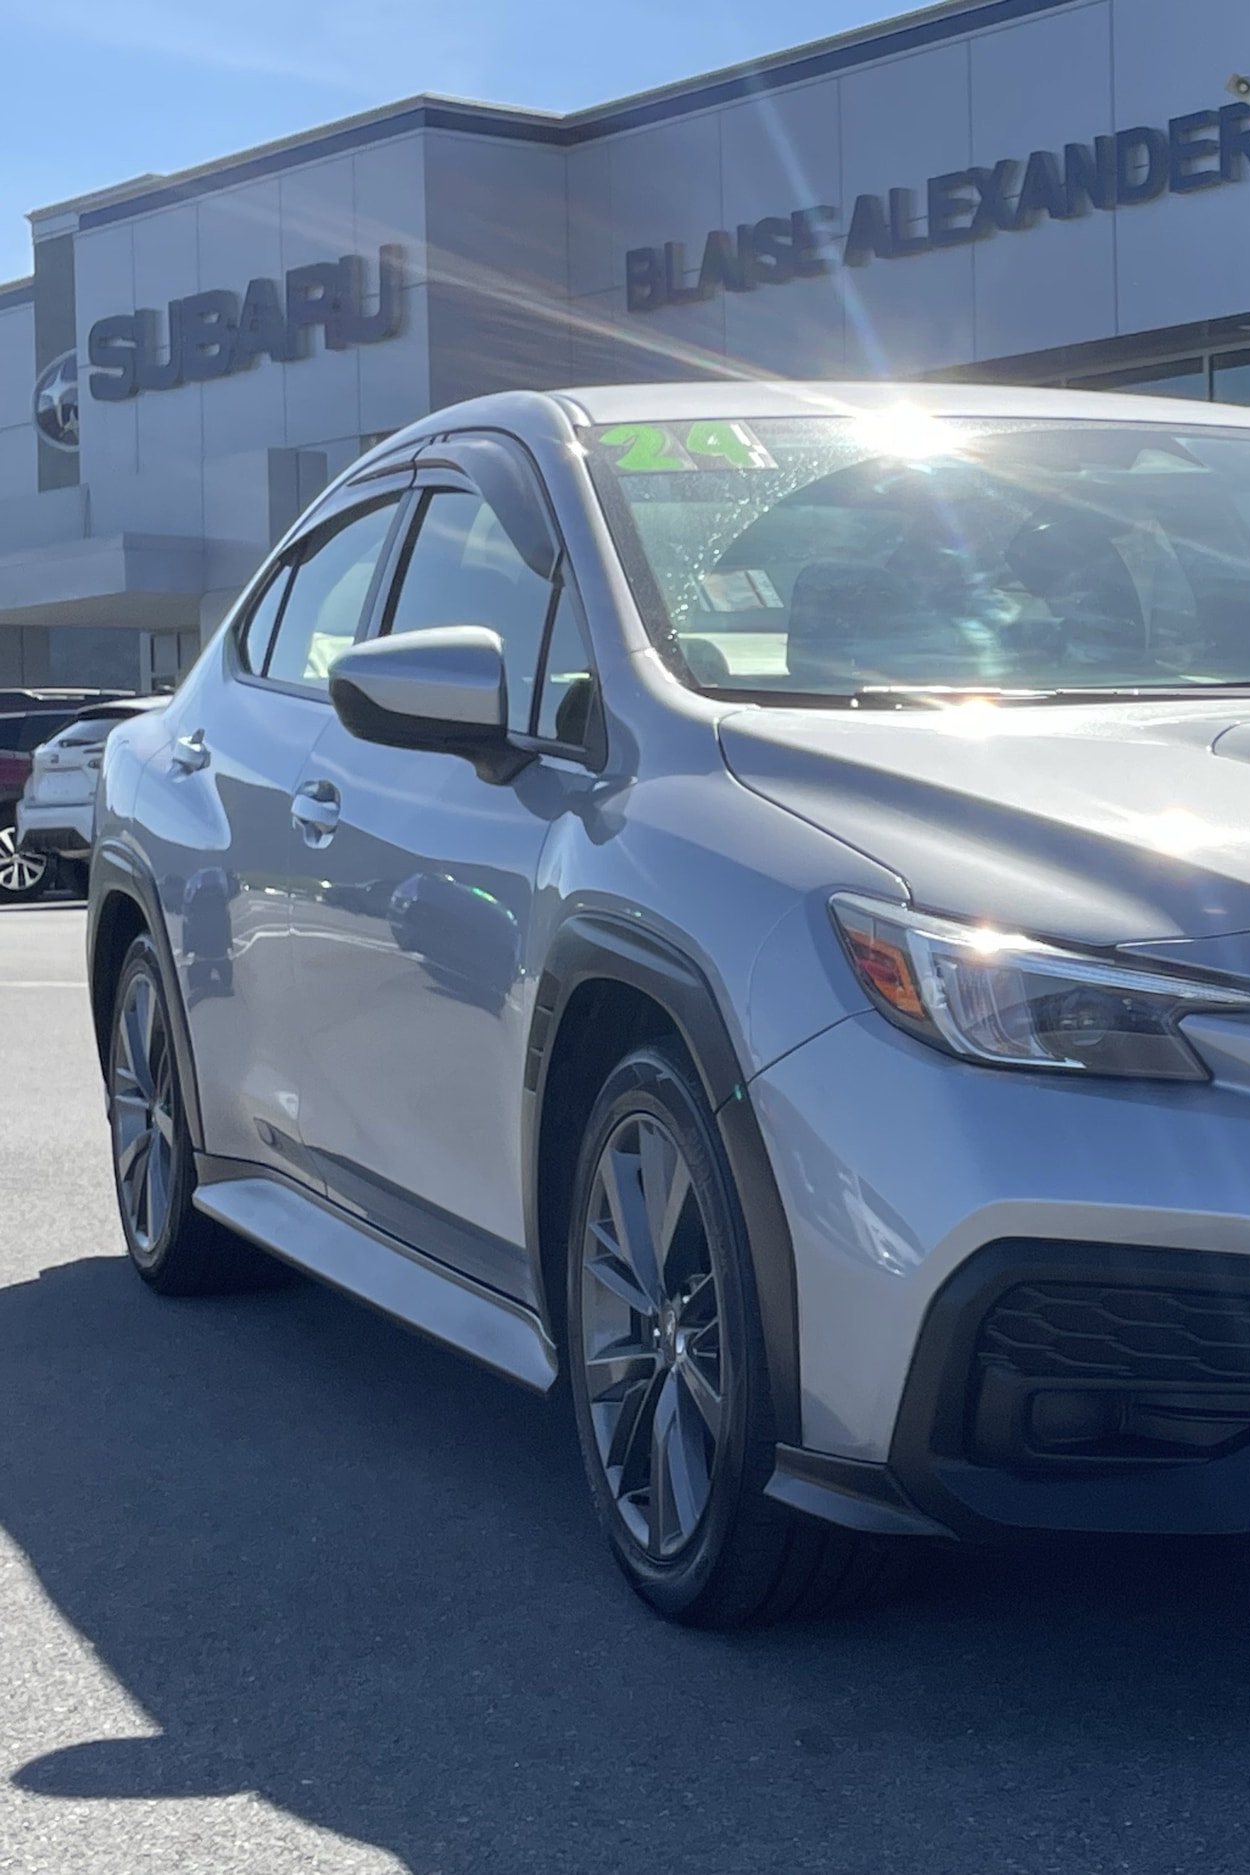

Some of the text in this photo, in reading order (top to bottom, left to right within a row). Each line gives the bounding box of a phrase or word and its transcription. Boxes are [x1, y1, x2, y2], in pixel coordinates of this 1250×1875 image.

[626, 204, 840, 313] BLAISE
[89, 243, 408, 402] SUBARU
[598, 421, 760, 471] 24
